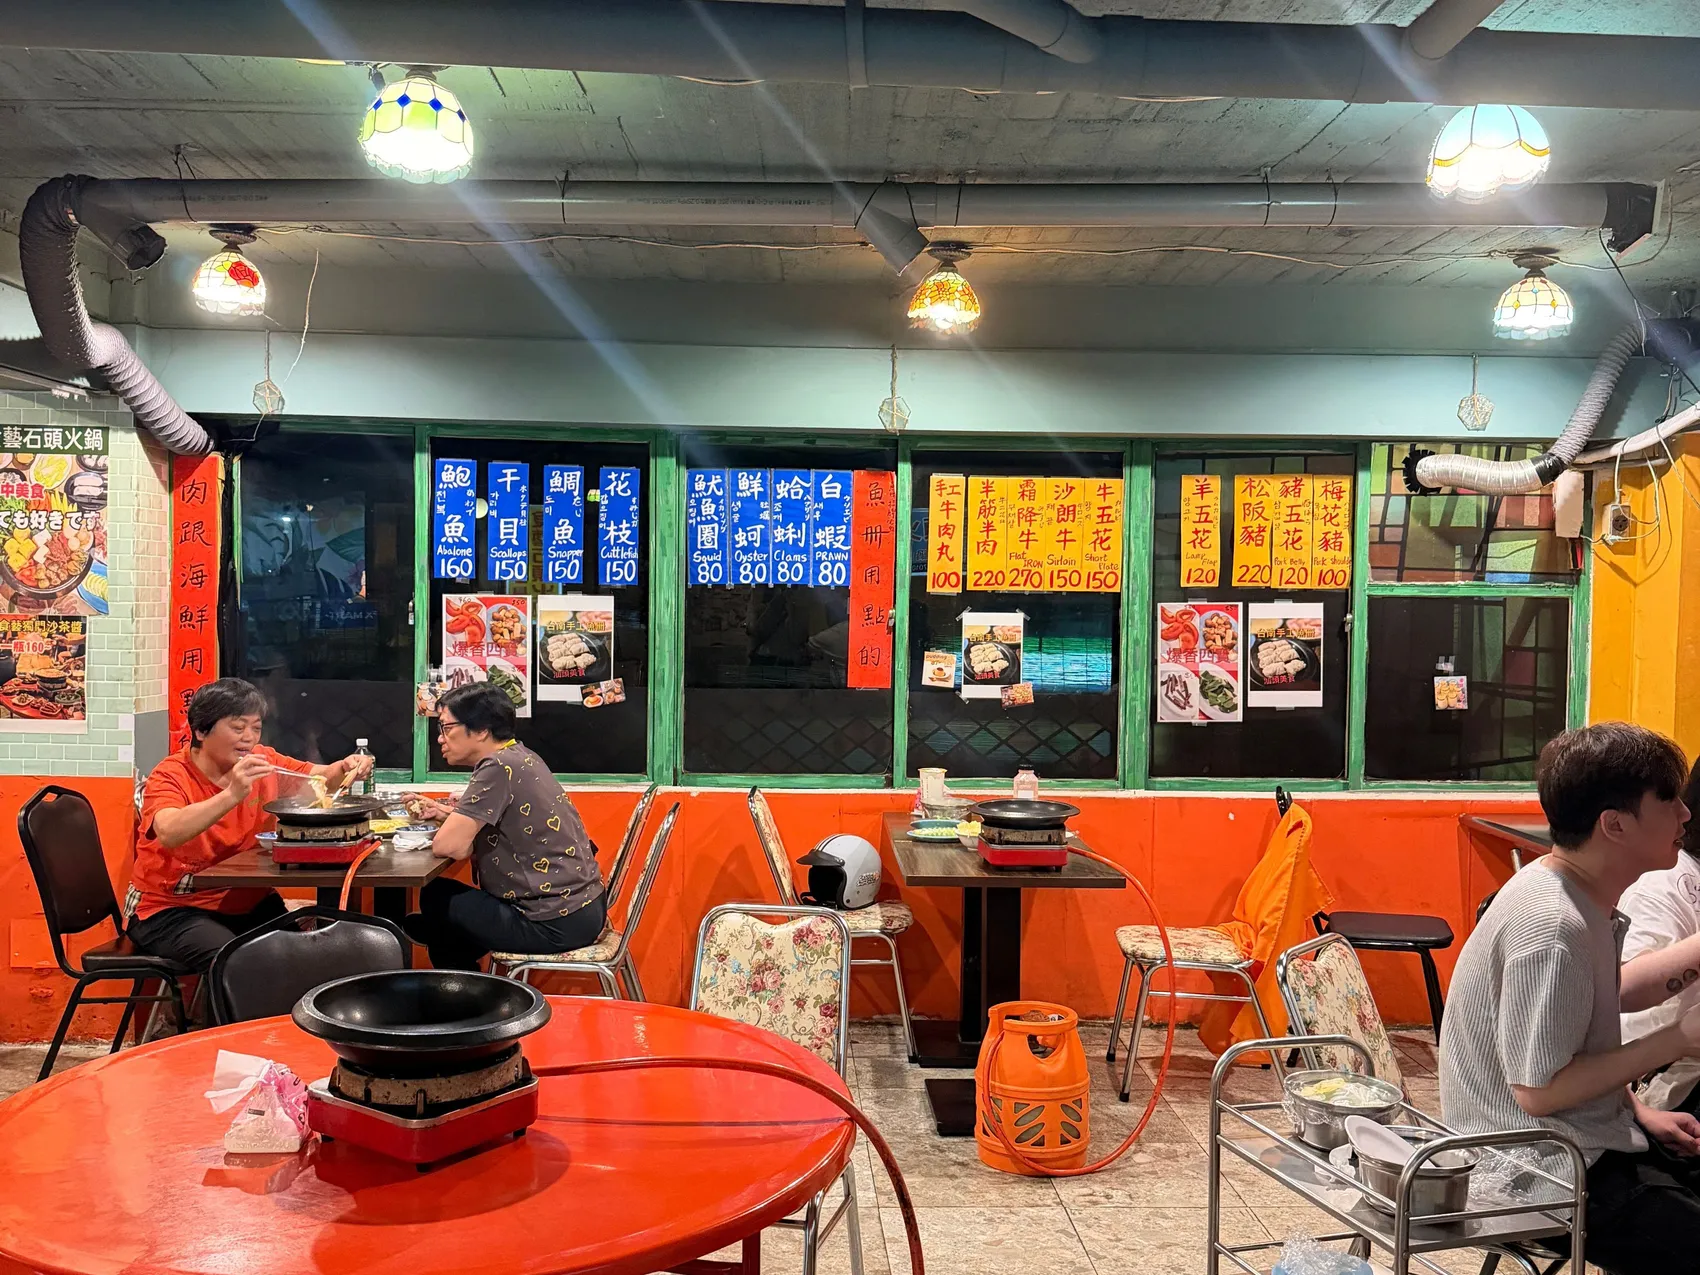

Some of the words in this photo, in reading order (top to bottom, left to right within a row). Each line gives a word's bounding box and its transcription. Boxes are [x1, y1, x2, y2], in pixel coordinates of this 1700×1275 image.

[0, 426, 103, 451] 藝石頭火鍋
[0, 482, 45, 499] 中美食
[439, 464, 471, 543] 鮑魚
[497, 468, 520, 546] 干貝
[550, 470, 581, 545] 鯛魚
[603, 471, 636, 546] 花枝
[691, 474, 723, 550] 魷魚圈
[734, 472, 765, 548] 鮮蚵
[774, 475, 811, 547] 蛤蜊
[814, 474, 851, 550] 白蝦
[1186, 477, 1213, 549] 羊五花
[1239, 477, 1270, 547] 松阪豬
[1279, 477, 1305, 551] 豬五花
[976, 479, 997, 556] 半筋半肉
[1017, 479, 1040, 550] 霜降牛
[1054, 482, 1076, 551] 沙朗牛
[1088, 482, 1115, 552] 牛五花
[1319, 480, 1346, 552] 梅花豬
[437, 544, 473, 556] Abalone
[490, 547, 527, 560] Scallops
[548, 546, 584, 560] Snapper
[600, 546, 639, 559] Cuttlefish
[693, 550, 722, 564] Squid
[734, 550, 768, 563] Oyster
[774, 550, 807, 562] Clams
[816, 551, 849, 561] PRAWN
[1009, 551, 1026, 560] Flat
[1023, 559, 1043, 568] IRON
[1046, 554, 1076, 566] Sirloin
[1084, 553, 1108, 562] Short
[440, 557, 473, 578] 160
[495, 560, 527, 580] 150
[548, 559, 580, 581] 150
[606, 560, 636, 582] 150
[698, 563, 723, 583] 80
[739, 563, 767, 584] 80
[777, 561, 804, 582] 80
[818, 561, 846, 585] 80
[1186, 568, 1216, 584] 120
[1237, 565, 1271, 584] 220
[1279, 567, 1308, 586] 120
[1317, 569, 1347, 587] 100
[932, 571, 961, 589] 100
[973, 570, 1006, 587] 220
[1009, 568, 1043, 589] 270
[1049, 569, 1081, 588] 150
[1086, 571, 1119, 589] 150
[178, 481, 213, 748] 肉跟海鮮用
